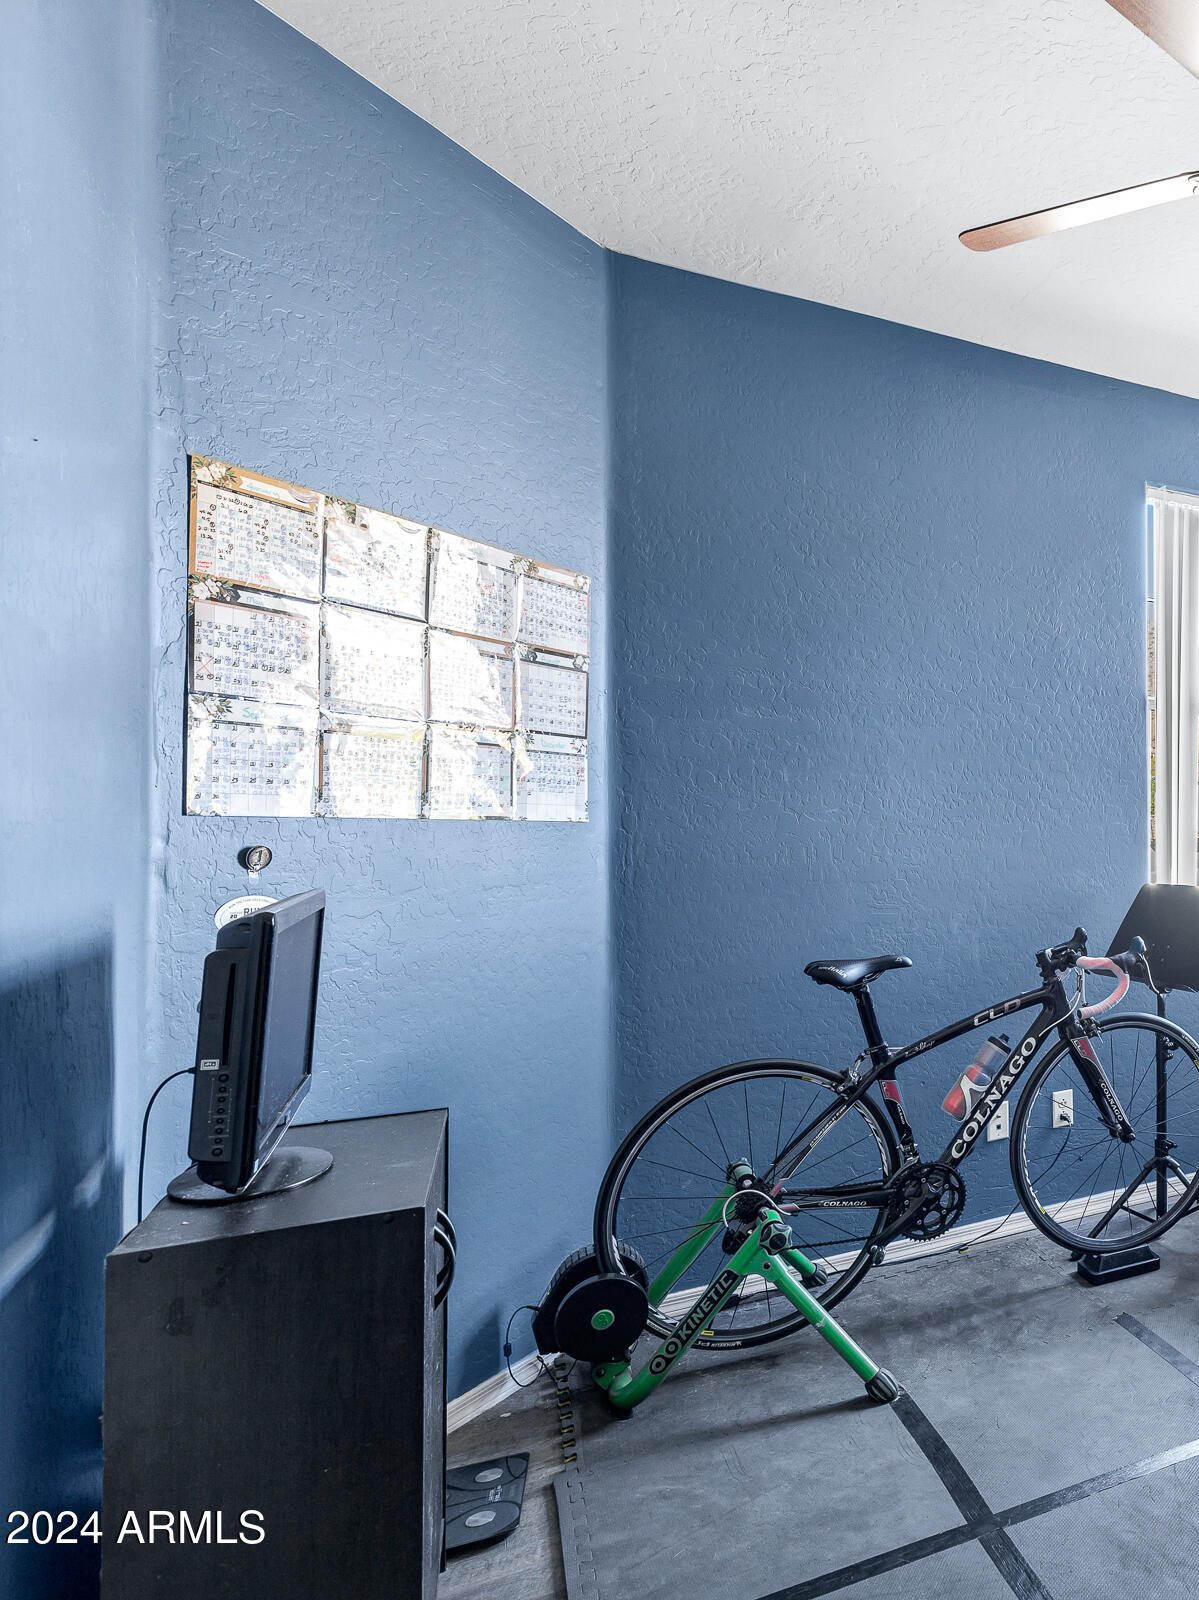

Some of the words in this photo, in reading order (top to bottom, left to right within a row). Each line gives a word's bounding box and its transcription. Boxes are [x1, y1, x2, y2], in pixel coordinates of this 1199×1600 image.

[973, 999, 1021, 1027] CLD
[951, 1036, 1037, 1159] COLNAGO
[1100, 1081, 1124, 1122] COLNAGO
[823, 1200, 868, 1208] COLNAGO
[678, 1273, 733, 1341] KINETIC
